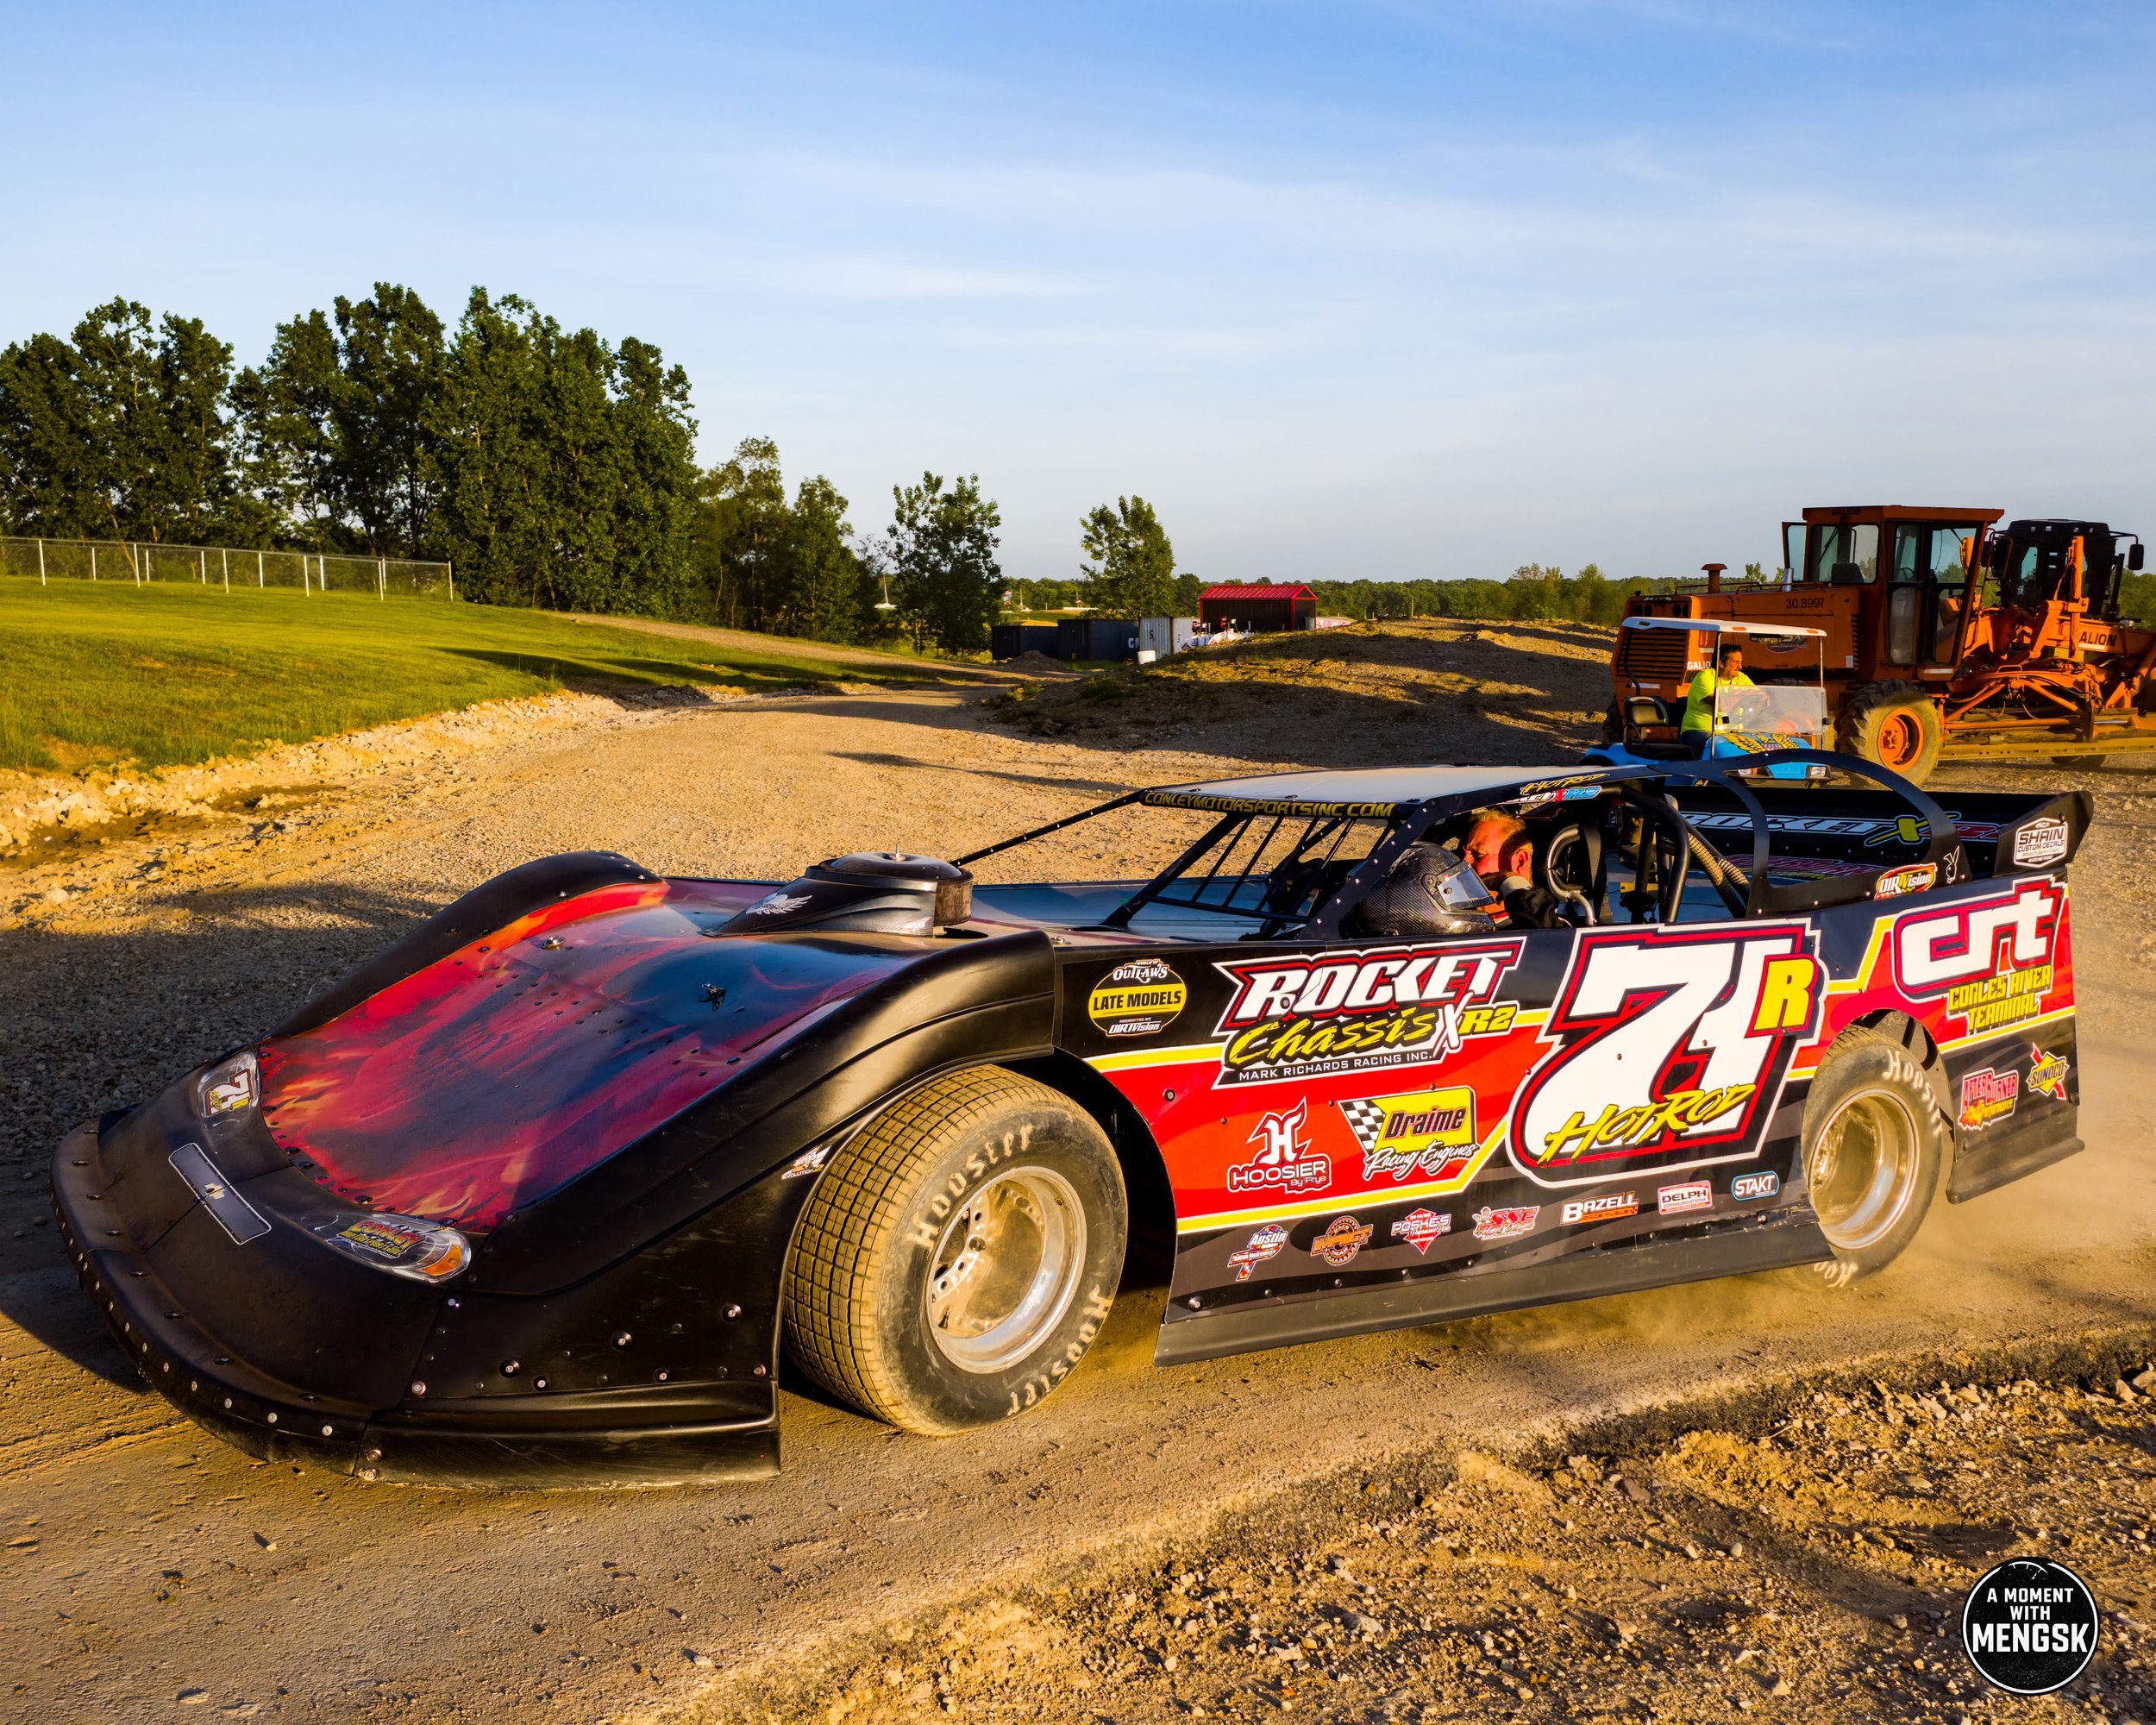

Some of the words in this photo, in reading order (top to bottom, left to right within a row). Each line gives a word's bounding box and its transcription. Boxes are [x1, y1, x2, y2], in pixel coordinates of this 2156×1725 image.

[2077, 630, 2117, 647] ALION
[1687, 661, 1712, 670] GALIO
[1144, 792, 1397, 818] CONLEYMOTORSPORTSINCCOM
[2018, 828, 2065, 845] SHAIN
[2018, 844, 2042, 853] CUSTOM
[1234, 950, 1514, 1019] ROCKET
[1093, 994, 1125, 1012] LATE
[1126, 990, 1182, 1008] MODELS
[1967, 992, 2039, 1031] TERMINAL
[1227, 1007, 1436, 1065] Chassis
[1238, 1068, 1279, 1081] MARK
[1283, 1060, 1350, 1076] RICHARDS
[1353, 1053, 1402, 1068] RACING
[1407, 1050, 1433, 1062] INC.
[2030, 1061, 2065, 1087] SUNOCO
[1383, 1107, 1467, 1139] Draime
[1365, 1148, 1420, 1179] Racing
[1419, 1138, 1478, 1174] Engines
[781, 1168, 814, 1181] EVOLUTION
[1232, 1160, 1327, 1187] HOOSIER
[1290, 1178, 1304, 1187] By
[1305, 1176, 1327, 1184] Frye
[1734, 1174, 1776, 1196] STAKT
[1562, 1194, 1638, 1223] BAZELL
[1661, 1189, 1707, 1203] DELPH
[348, 1219, 427, 1251] CONLEY
[1249, 1231, 1287, 1246] Austin
